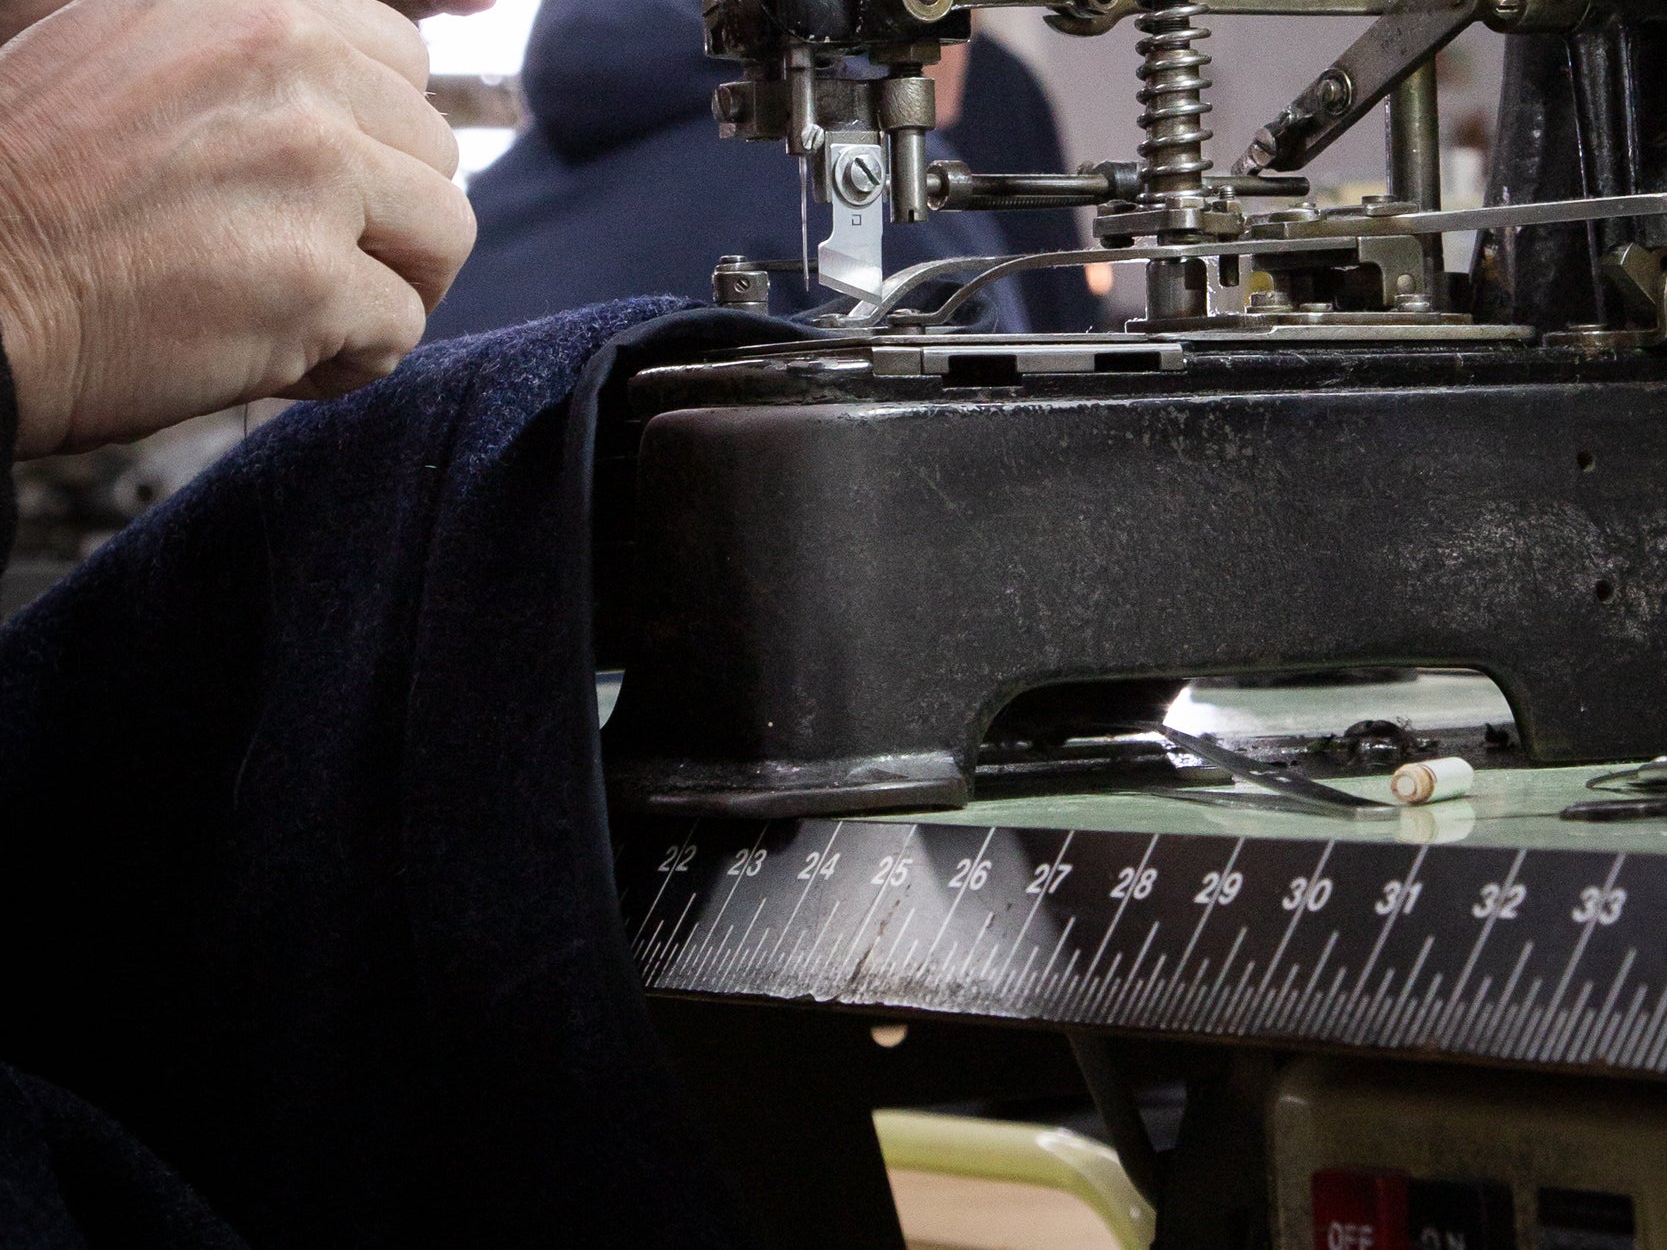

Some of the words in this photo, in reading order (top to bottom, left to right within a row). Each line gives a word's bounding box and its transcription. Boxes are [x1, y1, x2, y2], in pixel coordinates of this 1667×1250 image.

[657, 845, 697, 873] 22
[727, 848, 766, 878] 23
[798, 851, 841, 881] 24
[871, 855, 913, 886] 25
[949, 859, 993, 891] 26
[1026, 863, 1072, 895] 27
[1110, 867, 1158, 900] 28
[1194, 871, 1244, 906] 29
[1282, 877, 1334, 912] 30
[1375, 880, 1423, 916] 31
[1471, 883, 1527, 921] 32
[1571, 886, 1628, 926] 33
[1326, 1220, 1375, 1250] OFF
